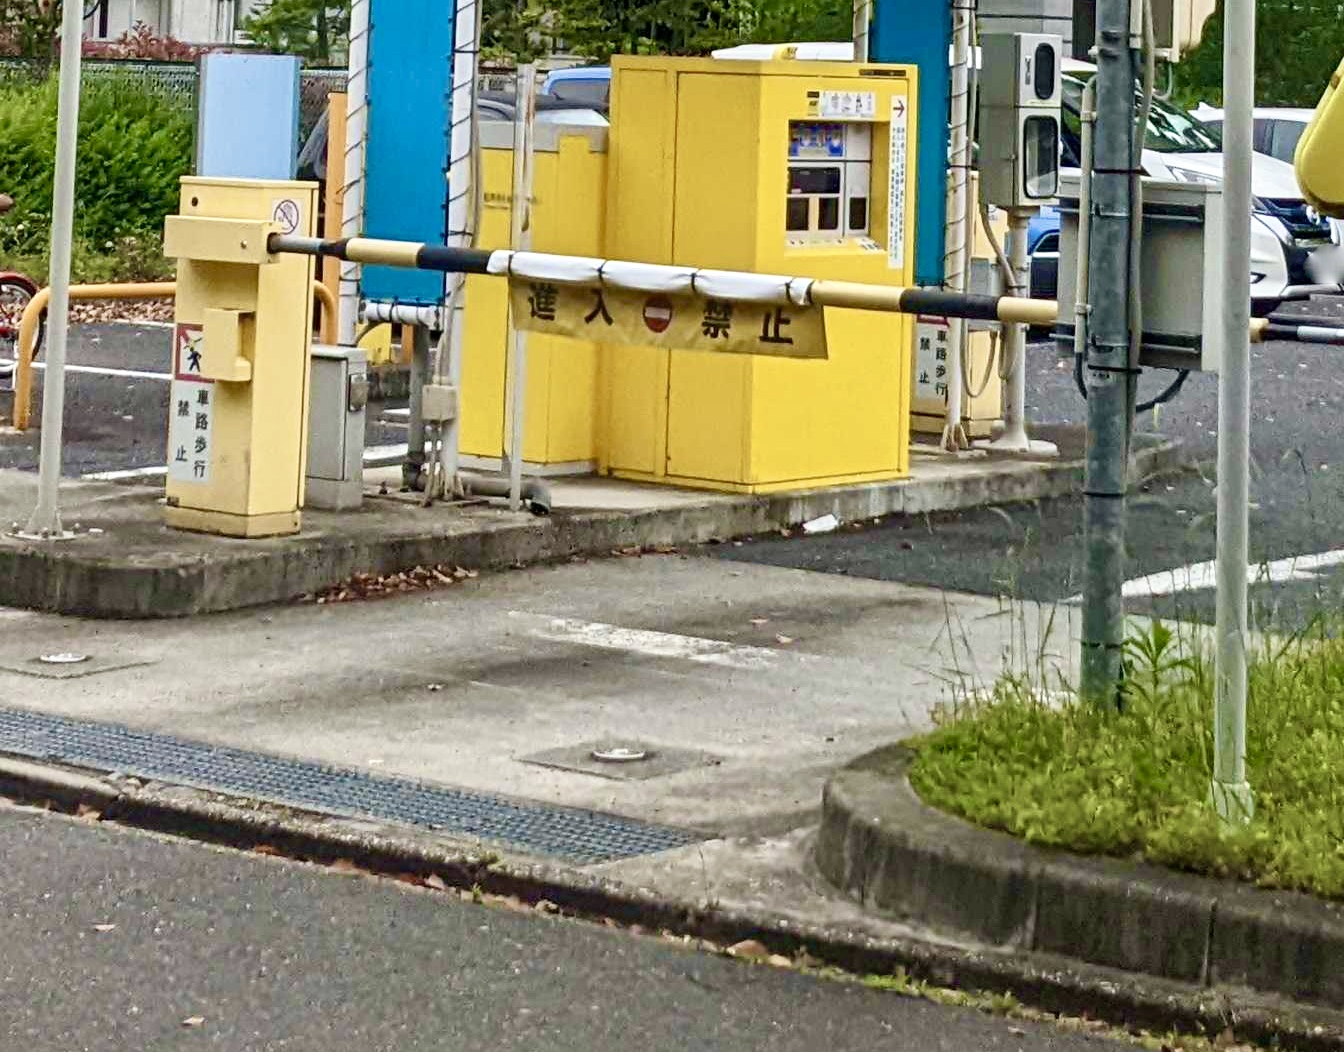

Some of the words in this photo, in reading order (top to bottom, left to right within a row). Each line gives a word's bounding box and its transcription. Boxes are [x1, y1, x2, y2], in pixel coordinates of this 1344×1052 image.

[528, 281, 613, 326] 進入
[701, 300, 794, 345] 禁止
[176, 400, 190, 462] 禁止
[193, 389, 209, 478] 車路歩行
